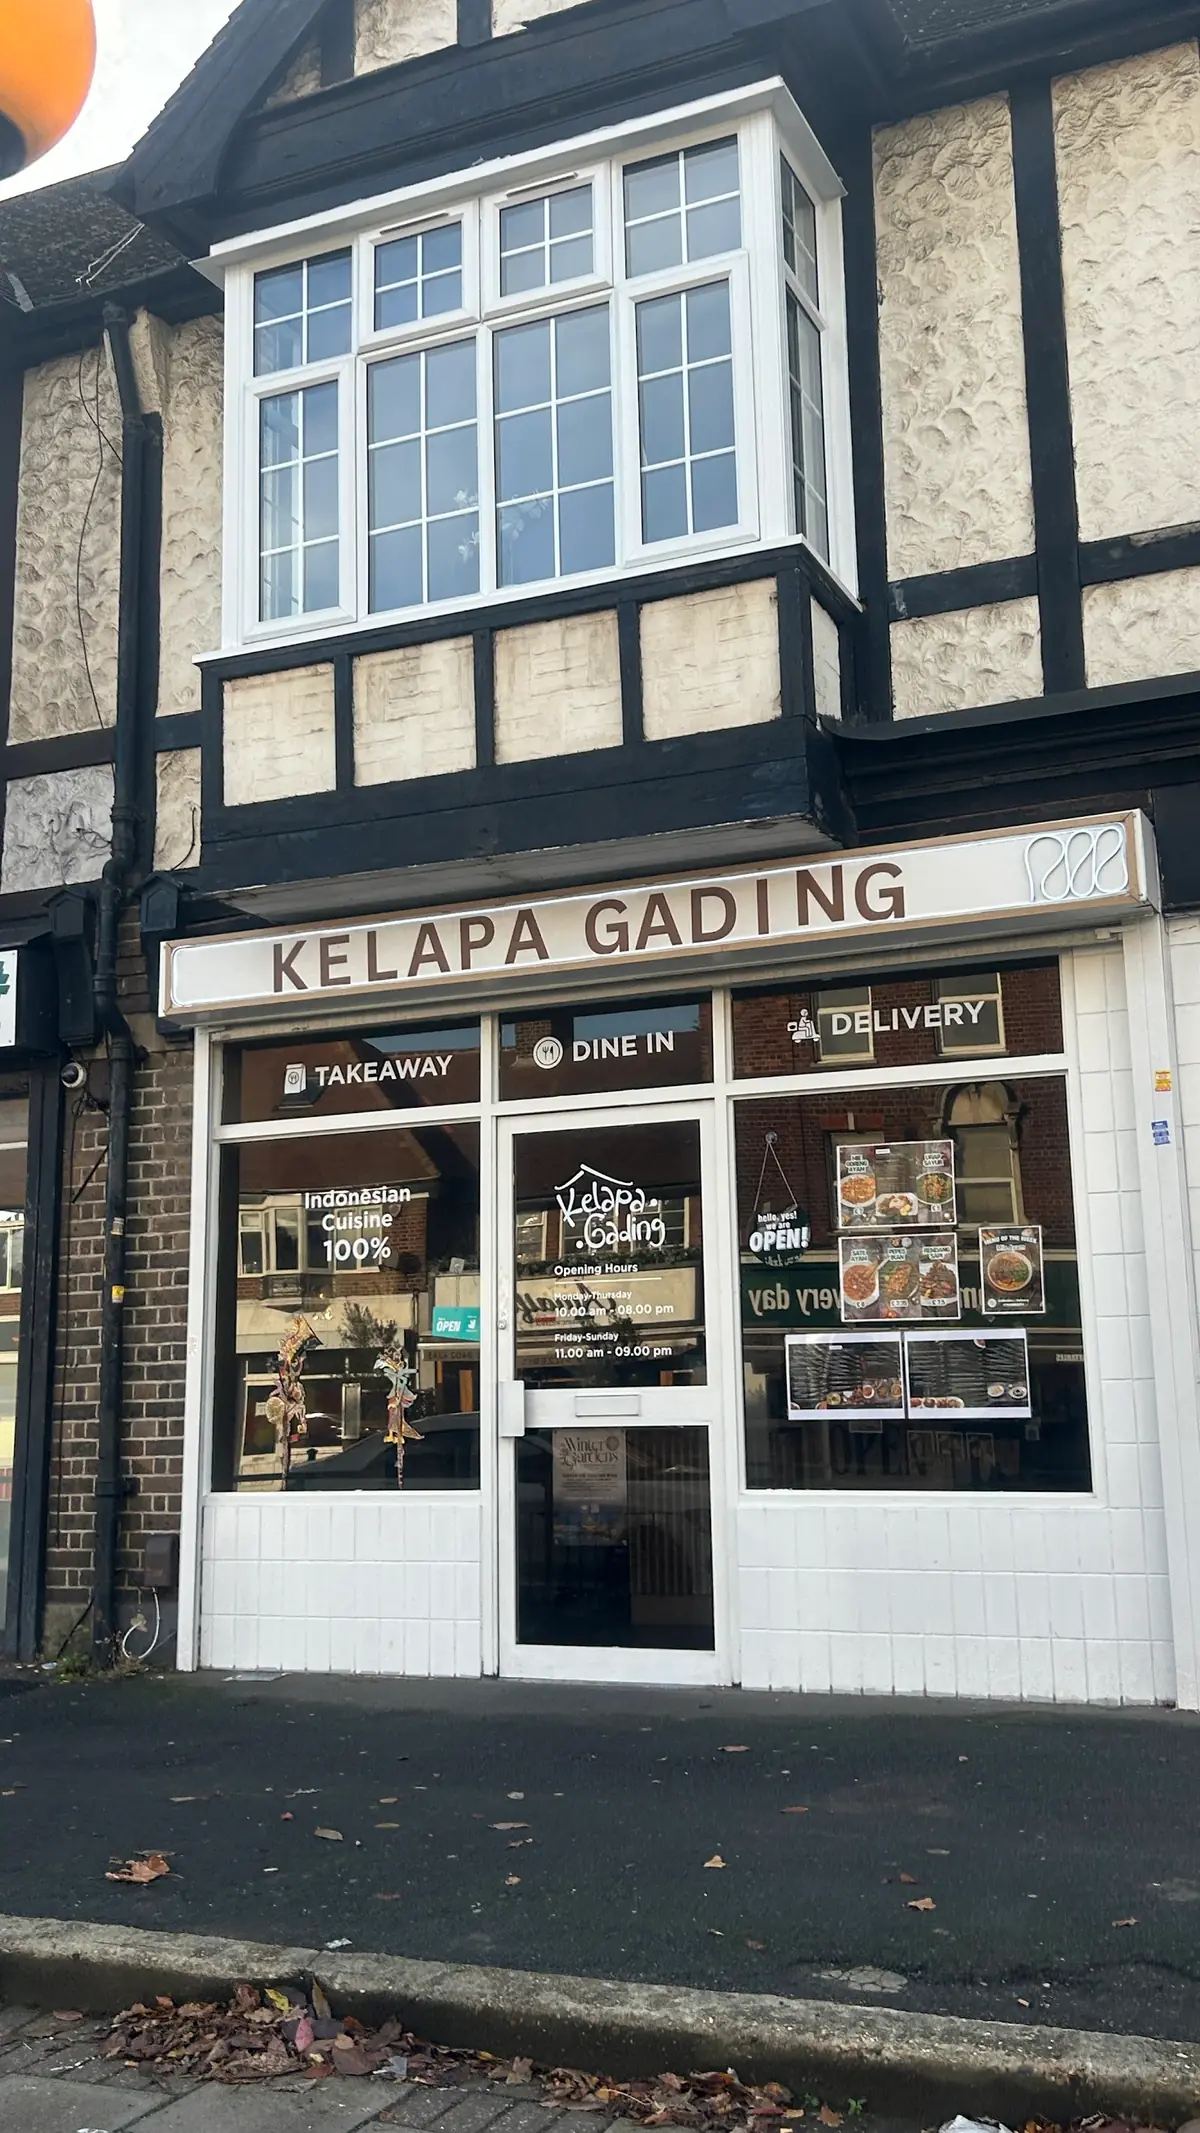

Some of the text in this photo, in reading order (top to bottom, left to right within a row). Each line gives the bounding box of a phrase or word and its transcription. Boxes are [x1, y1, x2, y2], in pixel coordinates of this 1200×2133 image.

[273, 862, 905, 993] KELAPA GADING
[831, 1000, 985, 1036] DELIVERY
[573, 1030, 675, 1062] DINE IN
[315, 1055, 453, 1087] TAKEAWAY
[304, 1187, 411, 1209] Indonesian
[556, 1181, 646, 1228] Kelapa
[322, 1211, 393, 1232] Cuisine
[757, 1210, 798, 1223] hello, yes!
[778, 1221, 791, 1229] are
[584, 1213, 666, 1249] Gading
[749, 1226, 809, 1253] OPEN!
[323, 1237, 392, 1262] 100%
[554, 1263, 639, 1277] Opening Hours
[554, 1290, 633, 1301] Monday-Thursday
[555, 1306, 587, 1318] 10.00
[589, 1307, 607, 1317] am
[617, 1304, 652, 1316] 08.00
[656, 1304, 675, 1316] pm
[436, 1320, 461, 1332] OPEN
[554, 1332, 620, 1343] Friday-Sunday
[555, 1348, 584, 1359] 11.00
[586, 1348, 605, 1358] am
[615, 1346, 651, 1358] 09.00
[654, 1346, 673, 1358] pm
[563, 1436, 604, 1452] Winter
